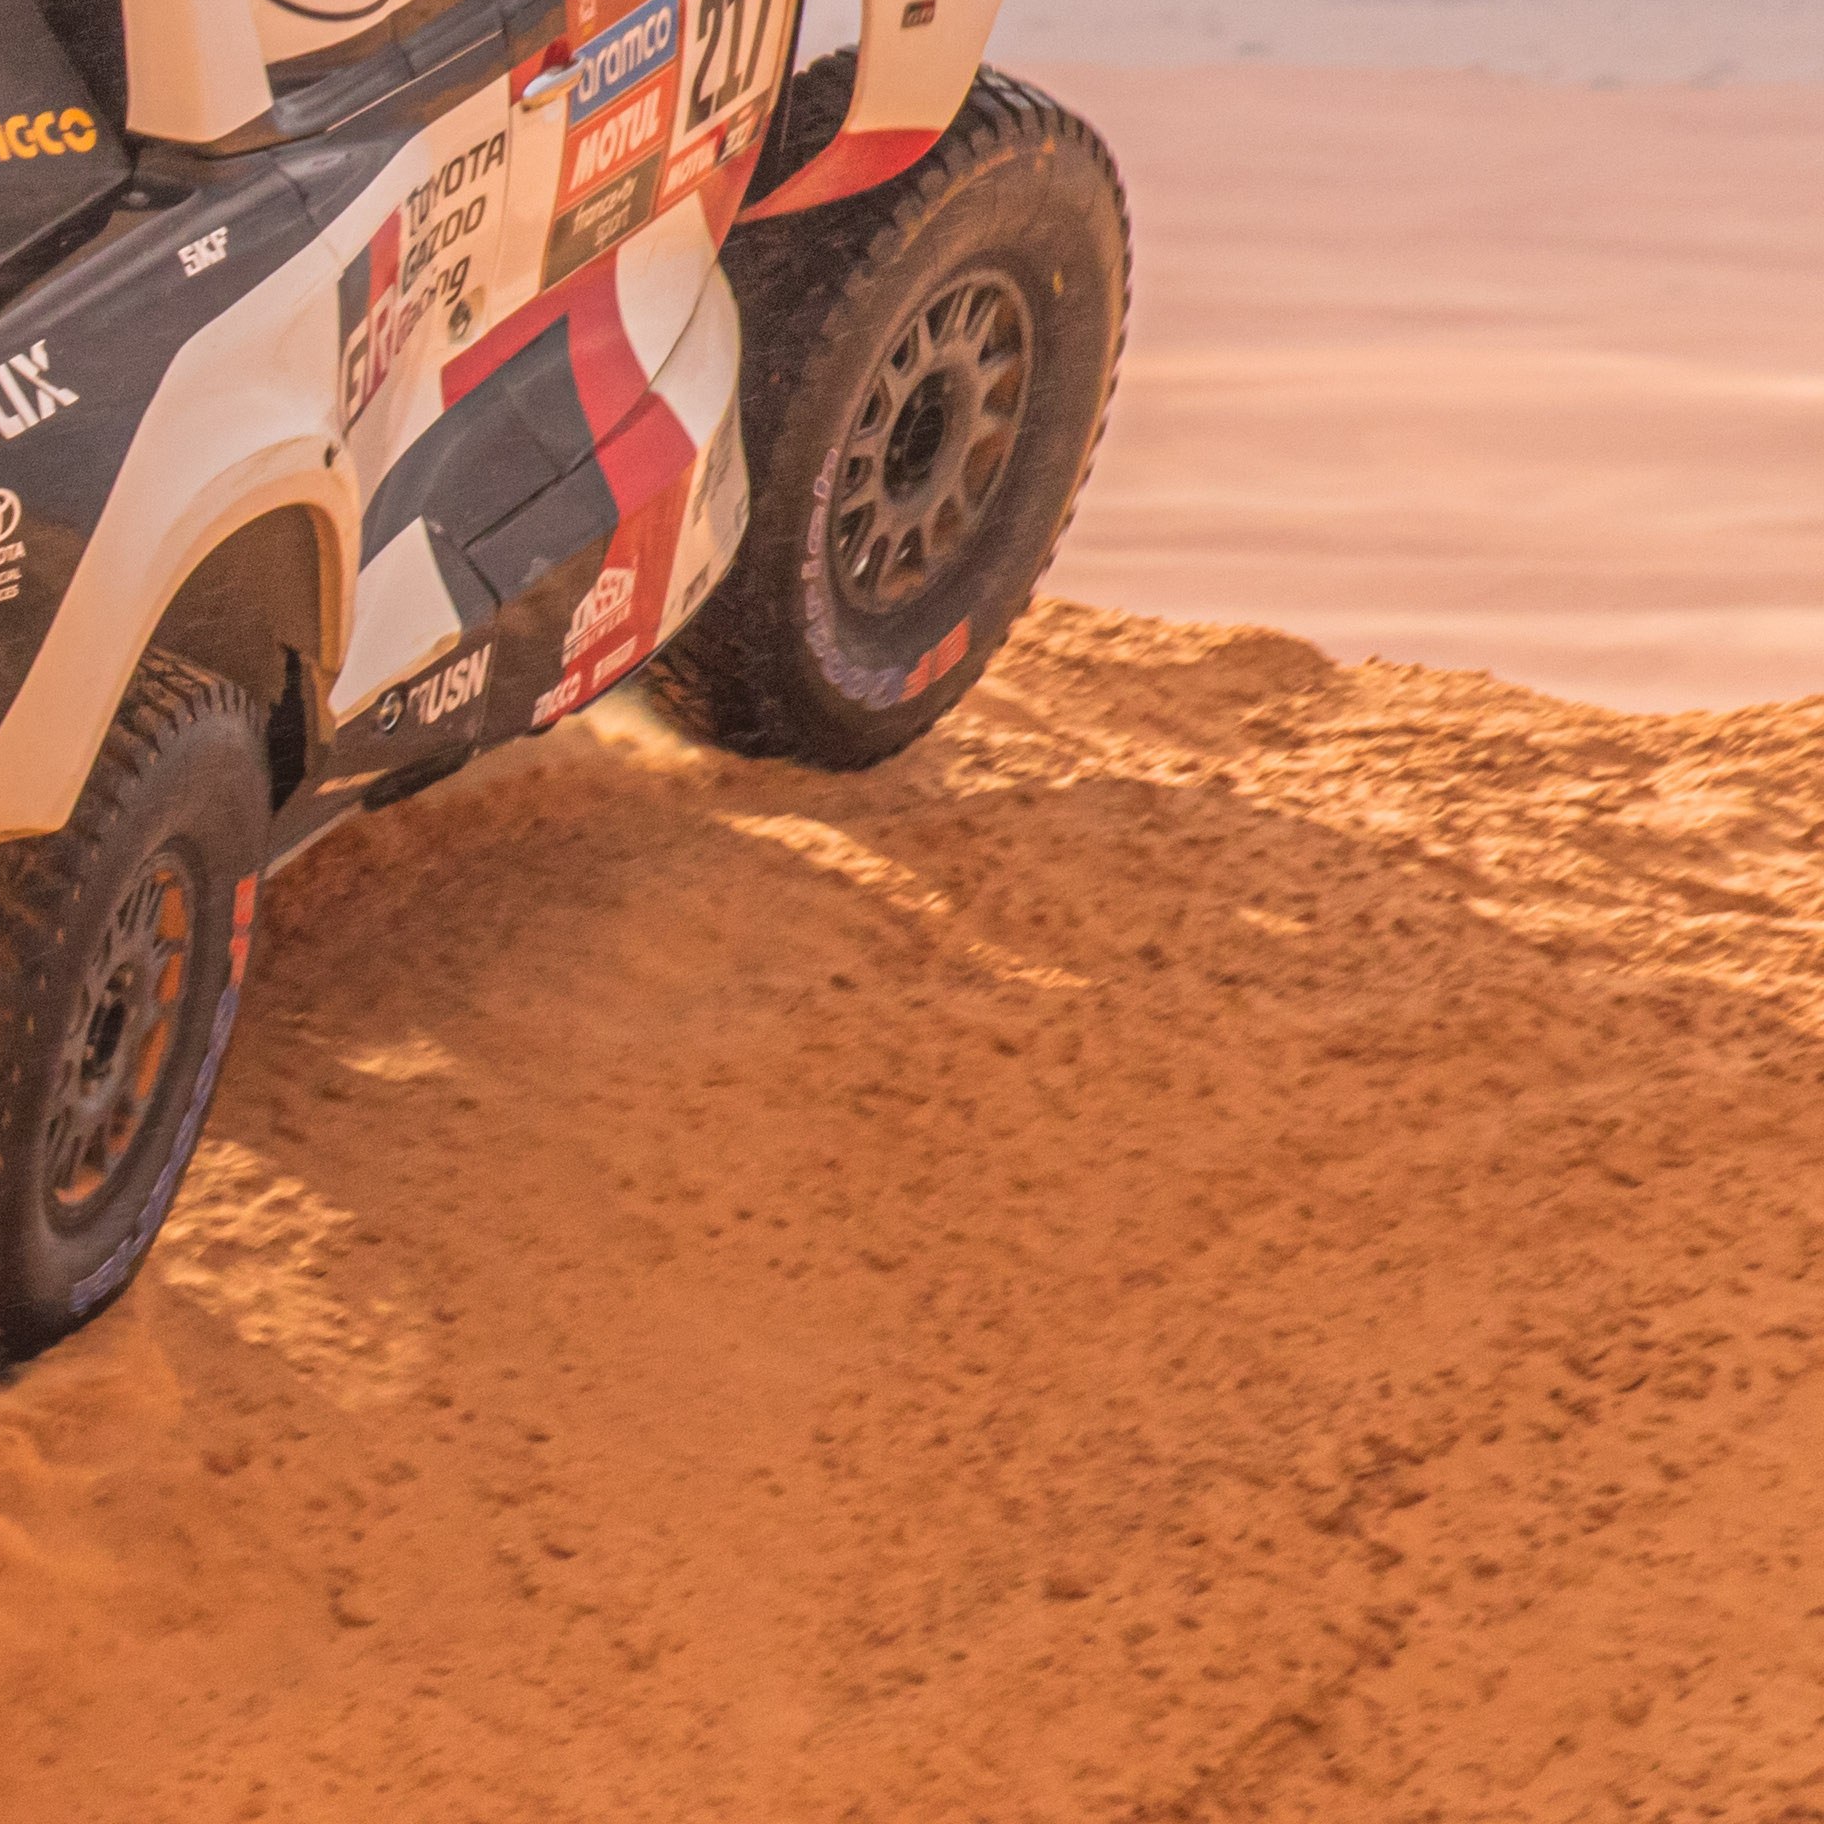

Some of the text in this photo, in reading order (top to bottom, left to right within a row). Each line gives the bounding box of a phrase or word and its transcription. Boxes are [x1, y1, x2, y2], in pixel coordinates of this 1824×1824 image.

[578, 4, 673, 104] aramco
[406, 128, 507, 238] TOYOTA
[568, 86, 662, 194] MOTUL
[176, 226, 230, 277] SKF
[402, 193, 487, 299] GAZOO
